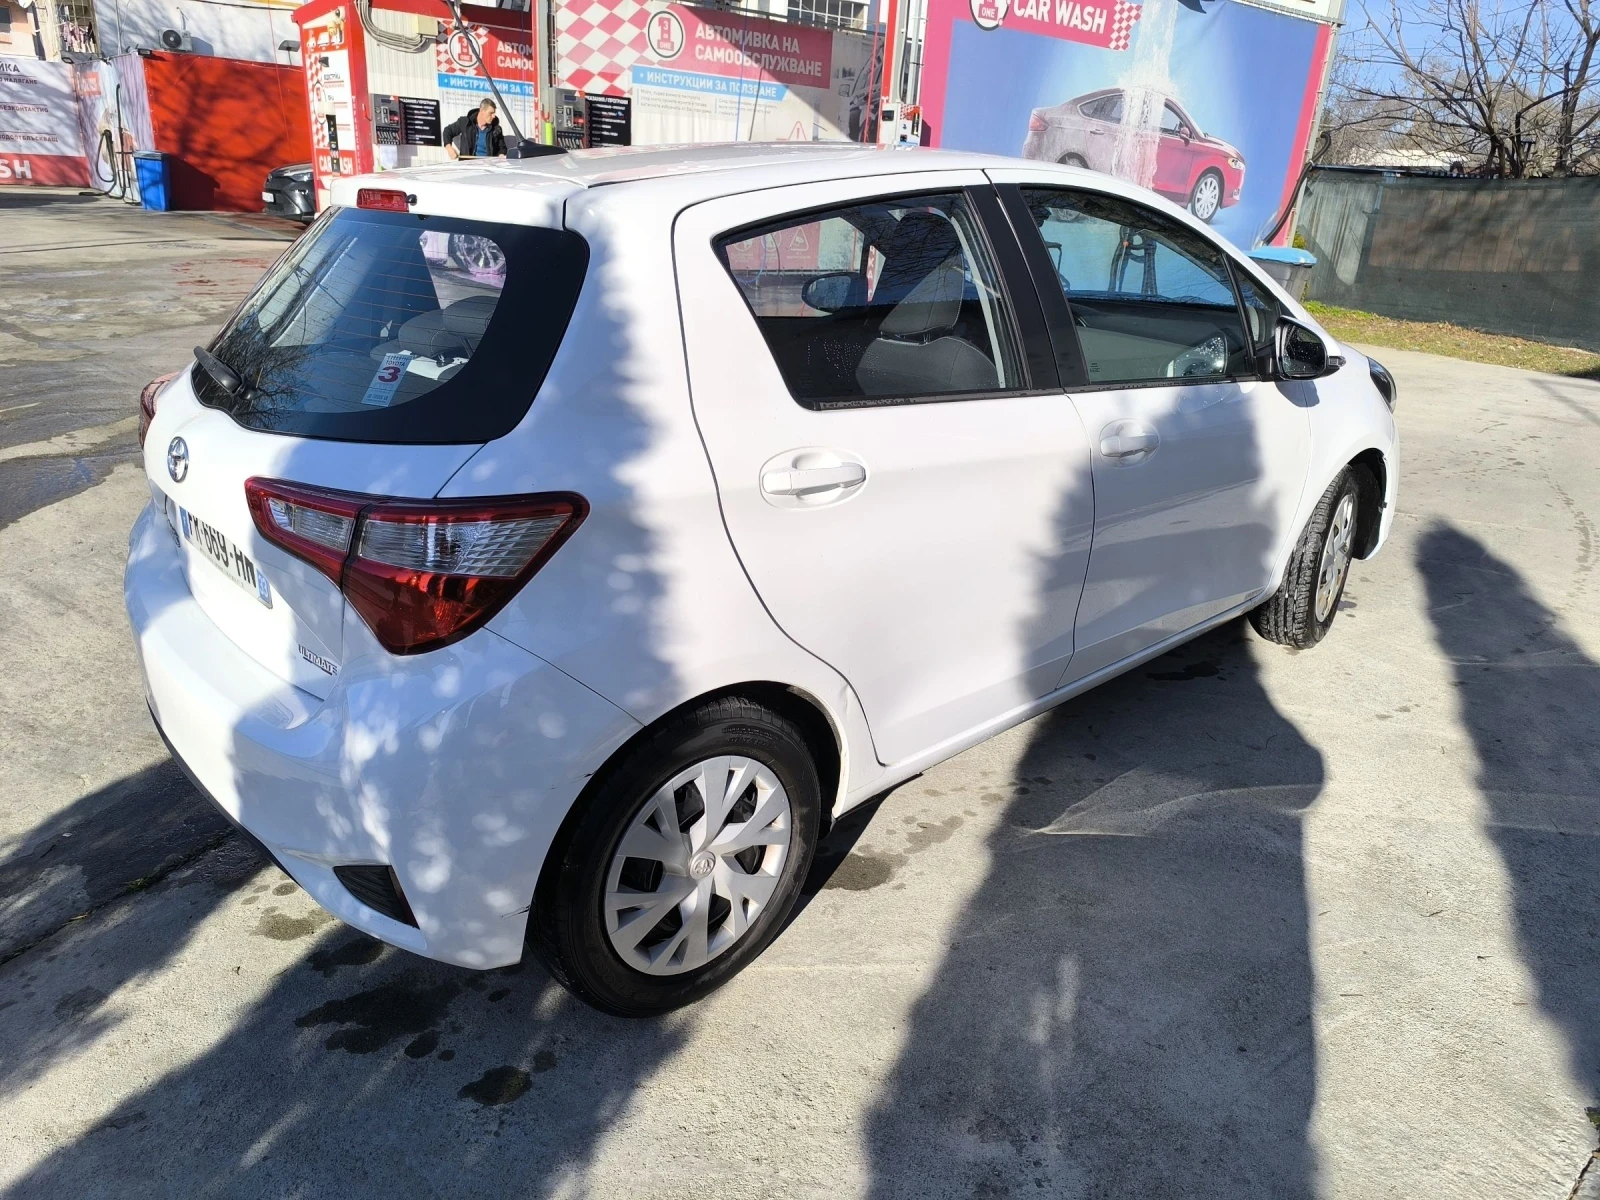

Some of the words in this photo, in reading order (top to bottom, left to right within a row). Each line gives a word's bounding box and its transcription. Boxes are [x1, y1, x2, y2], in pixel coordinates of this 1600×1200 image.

[981, 7, 996, 18] ONE
[1056, 0, 1107, 34] WASH
[695, 22, 779, 51] АВТОМИВКА
[782, 36, 800, 54] НА
[694, 44, 823, 77] САМООБСЛУЖВАНЕ
[647, 71, 713, 90] ИНСТРУКЦИИ
[714, 80, 727, 91] ЗА
[378, 366, 401, 383] 3
[298, 643, 338, 676] ULTIMATE
